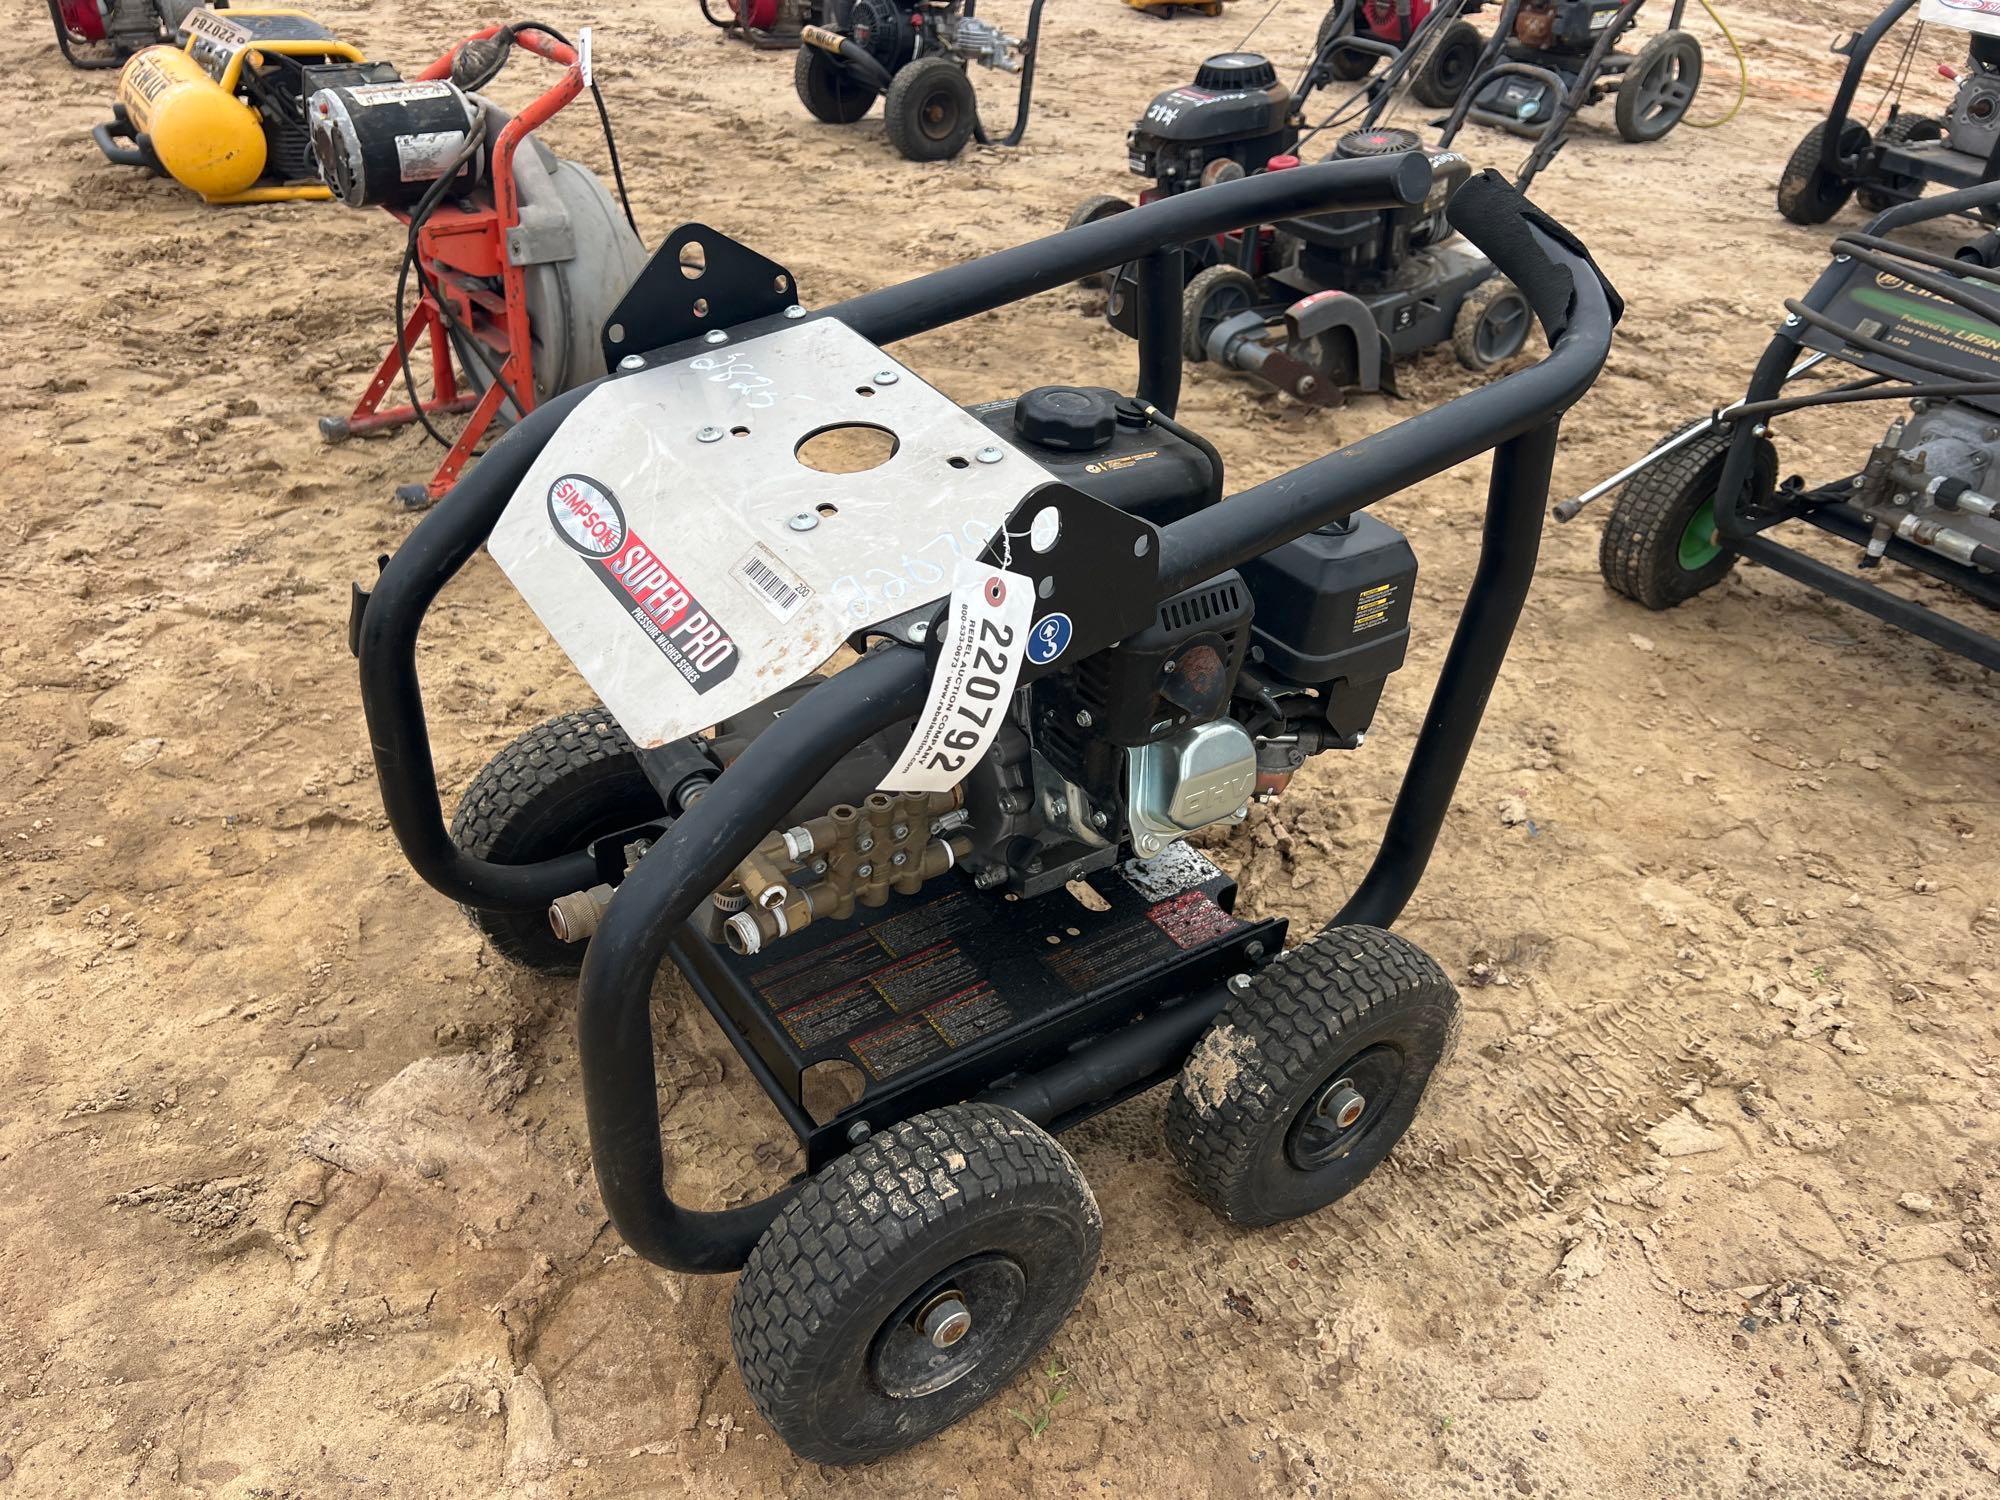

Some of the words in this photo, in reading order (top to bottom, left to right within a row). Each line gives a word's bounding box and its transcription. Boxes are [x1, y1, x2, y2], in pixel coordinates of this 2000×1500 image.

[190, 15, 236, 43] 220784
[1948, 341, 1993, 360] PRESSURE
[556, 482, 618, 547] SIMPSON
[611, 545, 689, 626] SUPER
[669, 610, 734, 673] PRO
[795, 582, 810, 598] 200
[631, 607, 662, 639] PRESSURE
[656, 634, 681, 664] WASHER
[677, 658, 700, 683] SERIES
[951, 603, 968, 668] 800-533-0673
[964, 619, 976, 659] REBEL
[926, 618, 1014, 772] 220792
[947, 662, 967, 712] AUCTION
[902, 676, 952, 774] www.rebelauction.com
[919, 713, 949, 765] COMPANY
